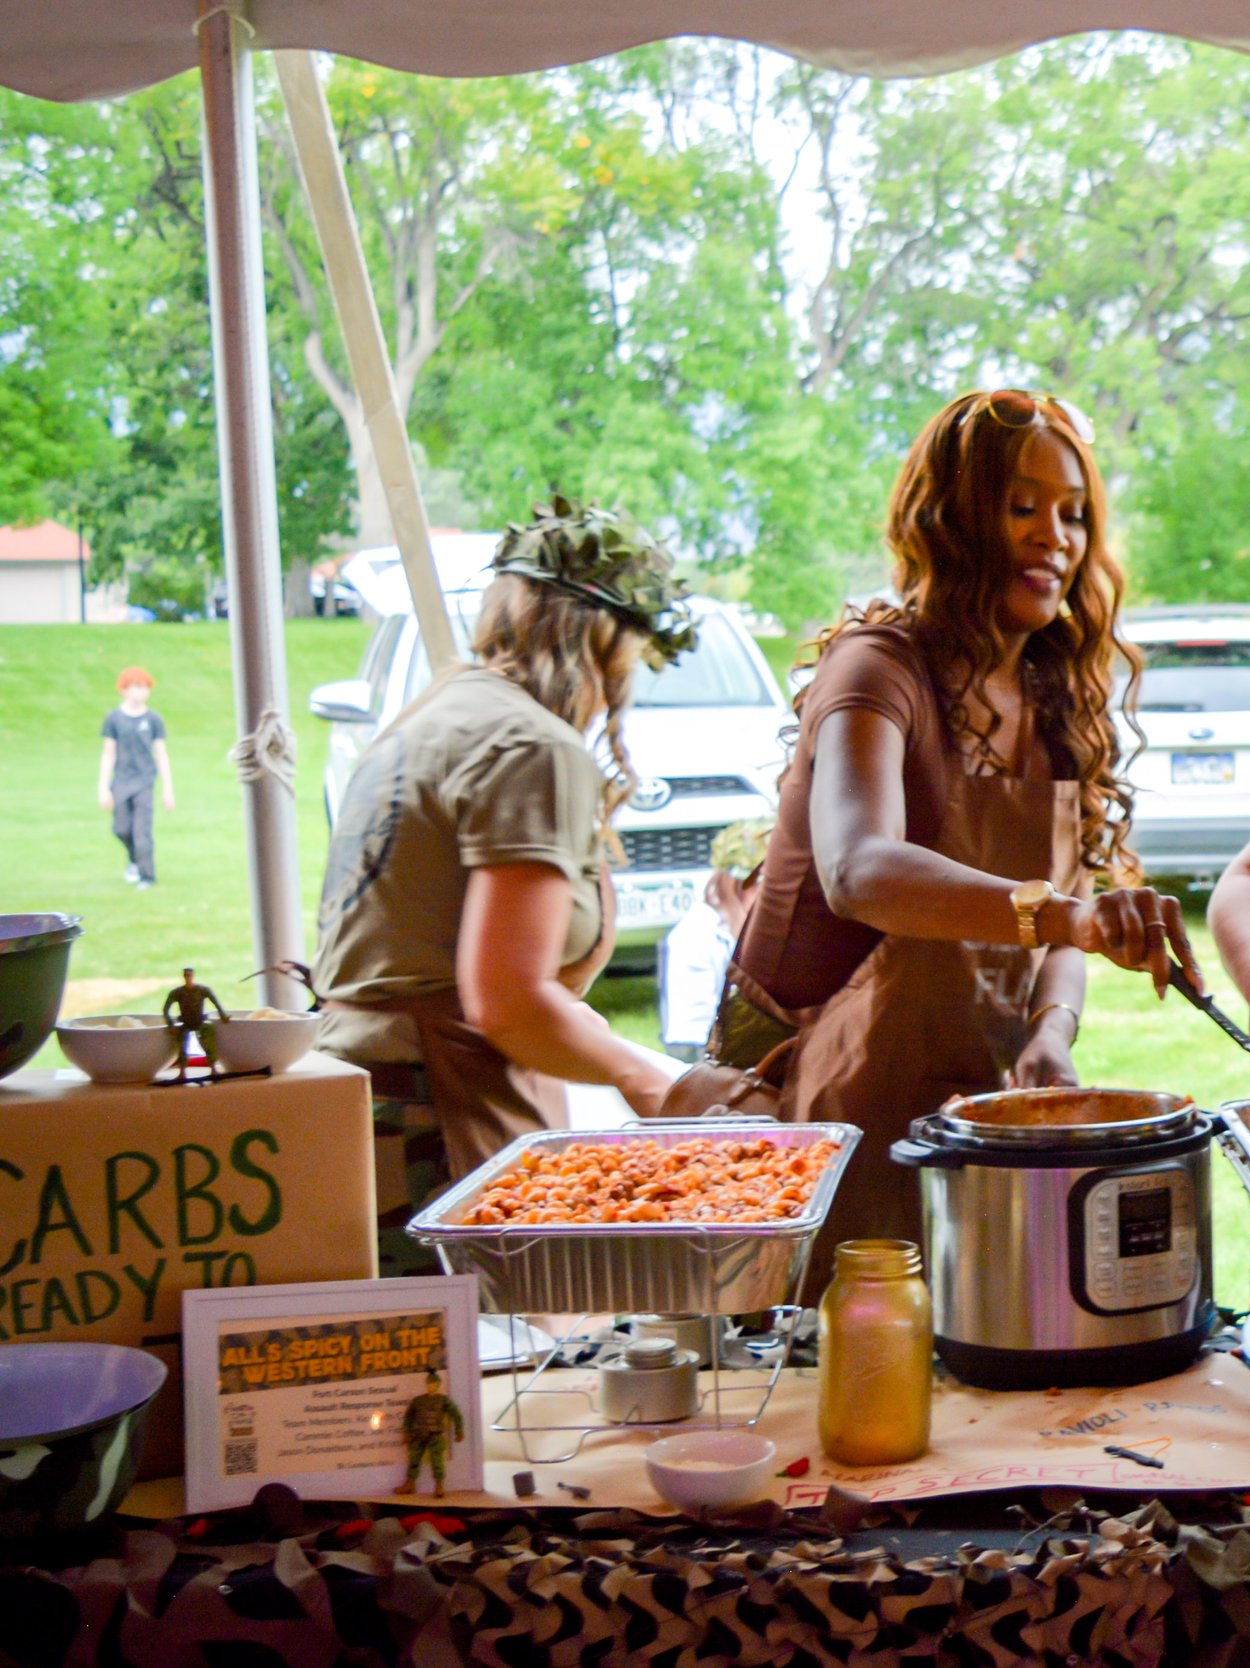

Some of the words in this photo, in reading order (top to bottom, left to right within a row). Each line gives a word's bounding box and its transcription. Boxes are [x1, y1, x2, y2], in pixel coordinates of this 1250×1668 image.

[0, 1258, 168, 1342] EADY
[285, 1336, 353, 1357] SPICY
[361, 1333, 392, 1349] ON
[397, 1327, 442, 1346] THE
[243, 1357, 354, 1384] WESTERN
[361, 1348, 431, 1373] FRONT
[912, 1464, 1098, 1493] SECRET
